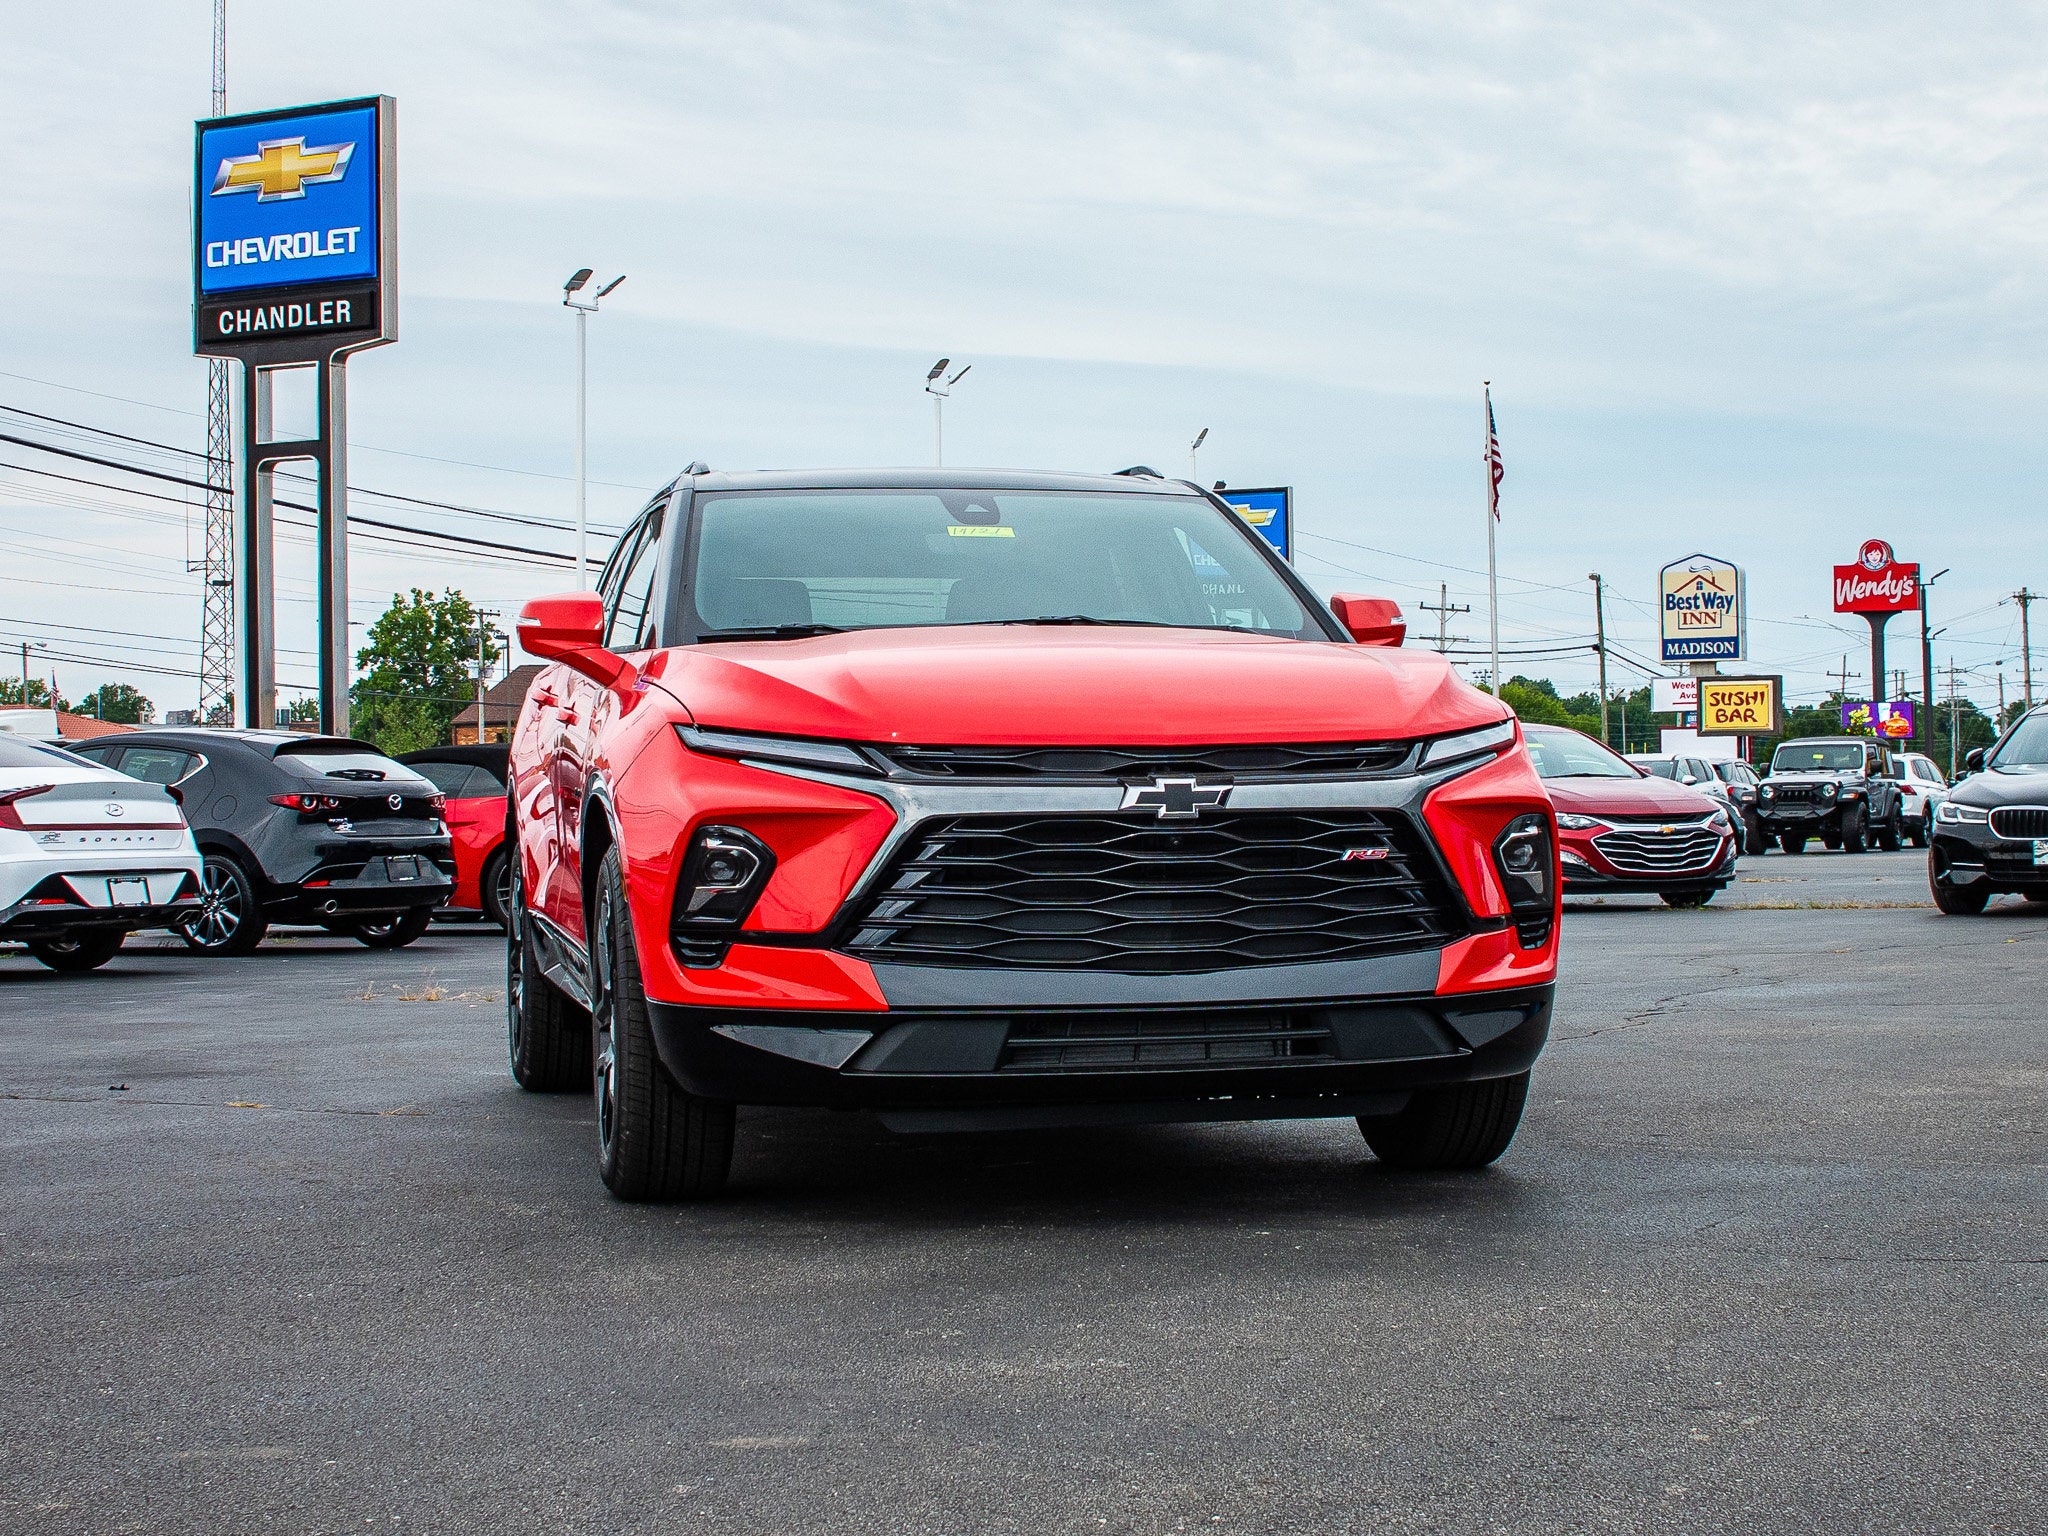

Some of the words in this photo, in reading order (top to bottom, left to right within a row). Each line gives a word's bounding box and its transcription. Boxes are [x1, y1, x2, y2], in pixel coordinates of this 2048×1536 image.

[207, 226, 361, 268] CHEVROLET
[218, 299, 351, 335] CHANDLER
[1836, 570, 1914, 605] Wendy's
[1665, 592, 1700, 611] Best
[1701, 591, 1734, 615] Way
[1681, 611, 1717, 625] INN
[1666, 641, 1735, 656] MADISON
[1709, 691, 1765, 707] SUSHI
[1715, 708, 1758, 723] BAR
[1341, 848, 1390, 861] RS
